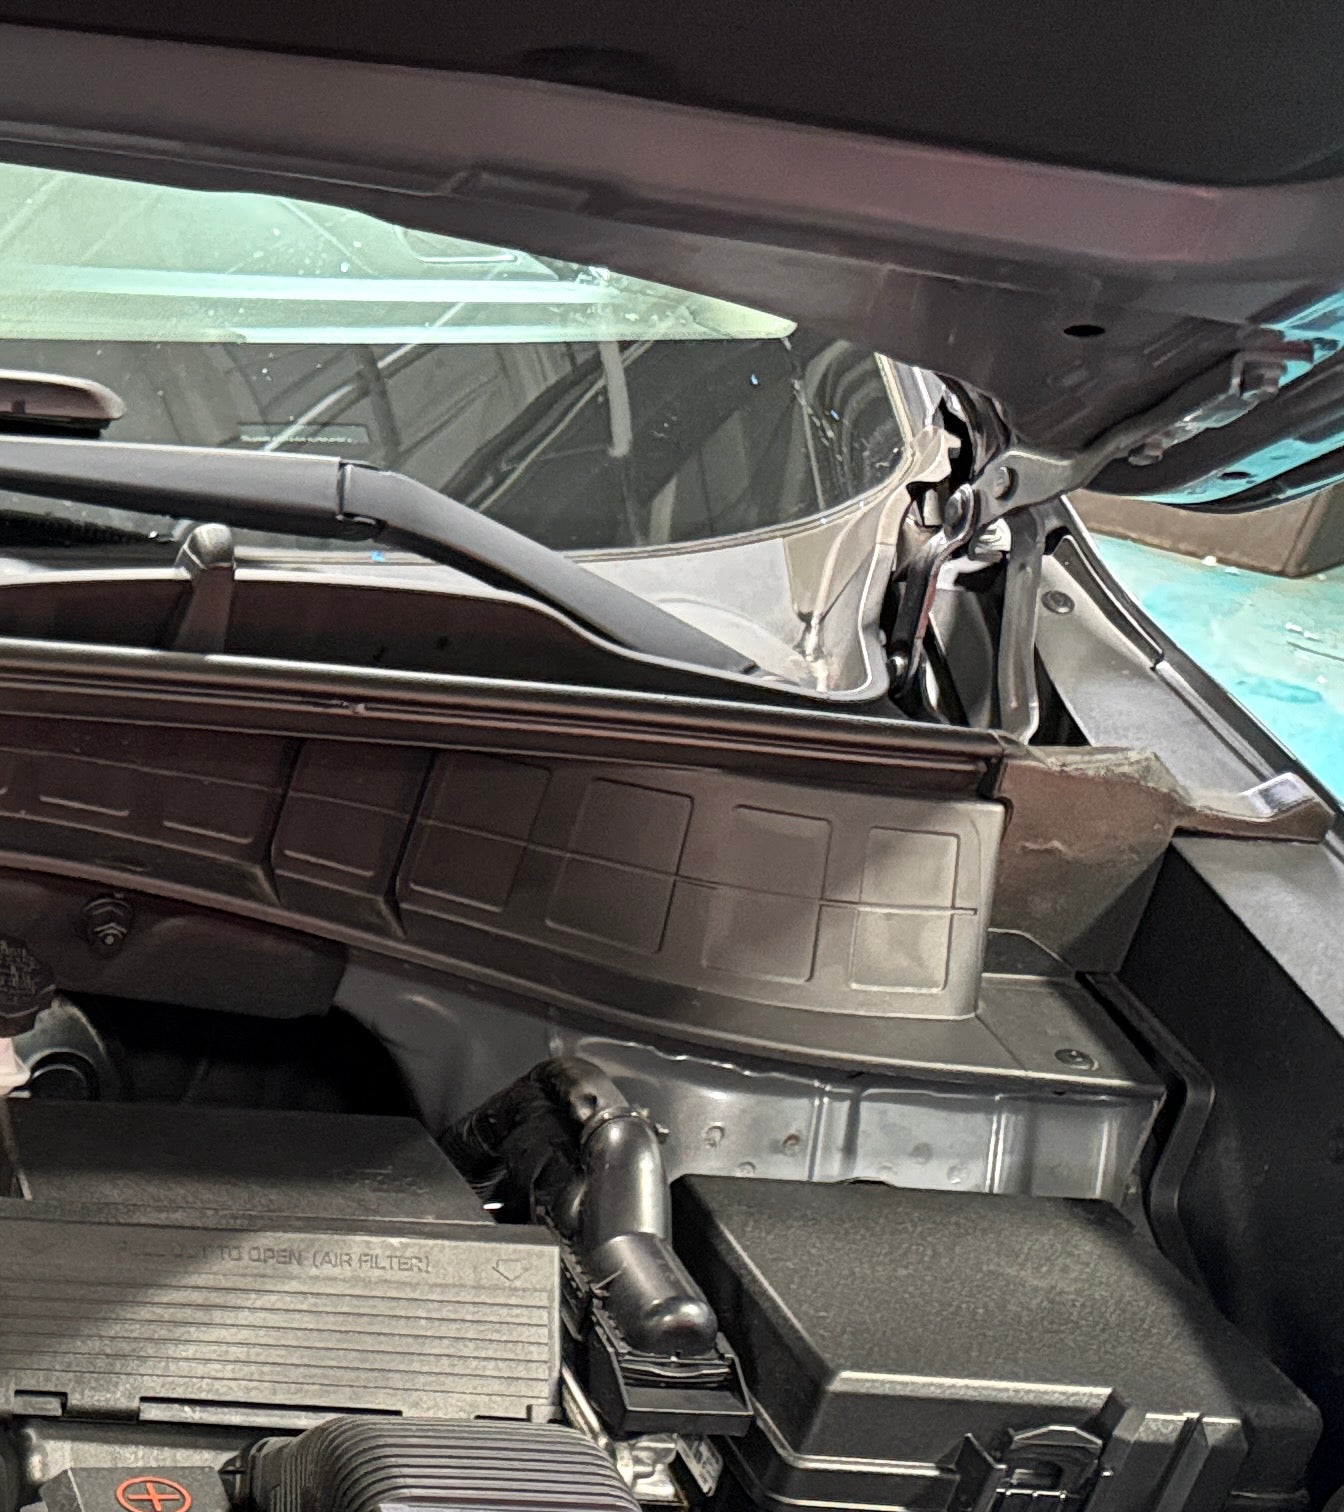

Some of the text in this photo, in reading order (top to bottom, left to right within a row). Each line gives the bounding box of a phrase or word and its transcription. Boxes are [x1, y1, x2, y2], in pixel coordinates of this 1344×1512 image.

[218, 1245, 242, 1262] TO
[248, 1246, 304, 1267] OPEN
[312, 1249, 353, 1270] (AIR
[358, 1252, 432, 1275] FILTER)
